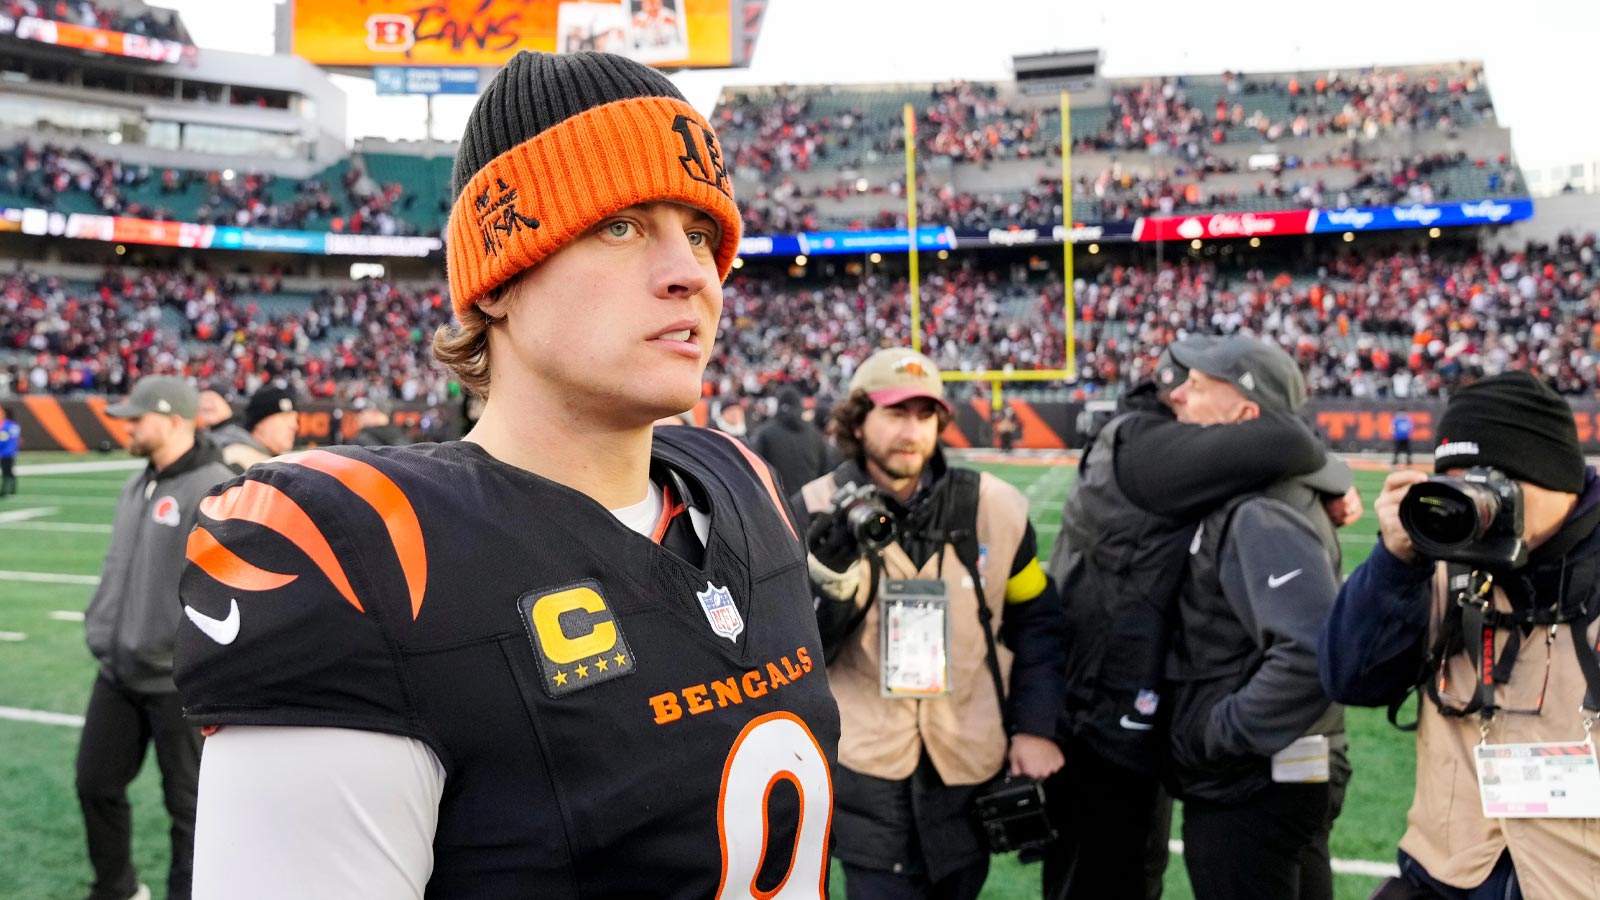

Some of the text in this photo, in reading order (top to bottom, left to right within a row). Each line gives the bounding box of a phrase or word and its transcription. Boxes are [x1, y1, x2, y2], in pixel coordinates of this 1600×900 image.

[1317, 411, 1432, 440] THE
[532, 586, 617, 664] C
[711, 607, 739, 631] NFL
[649, 646, 813, 725] BENGALS
